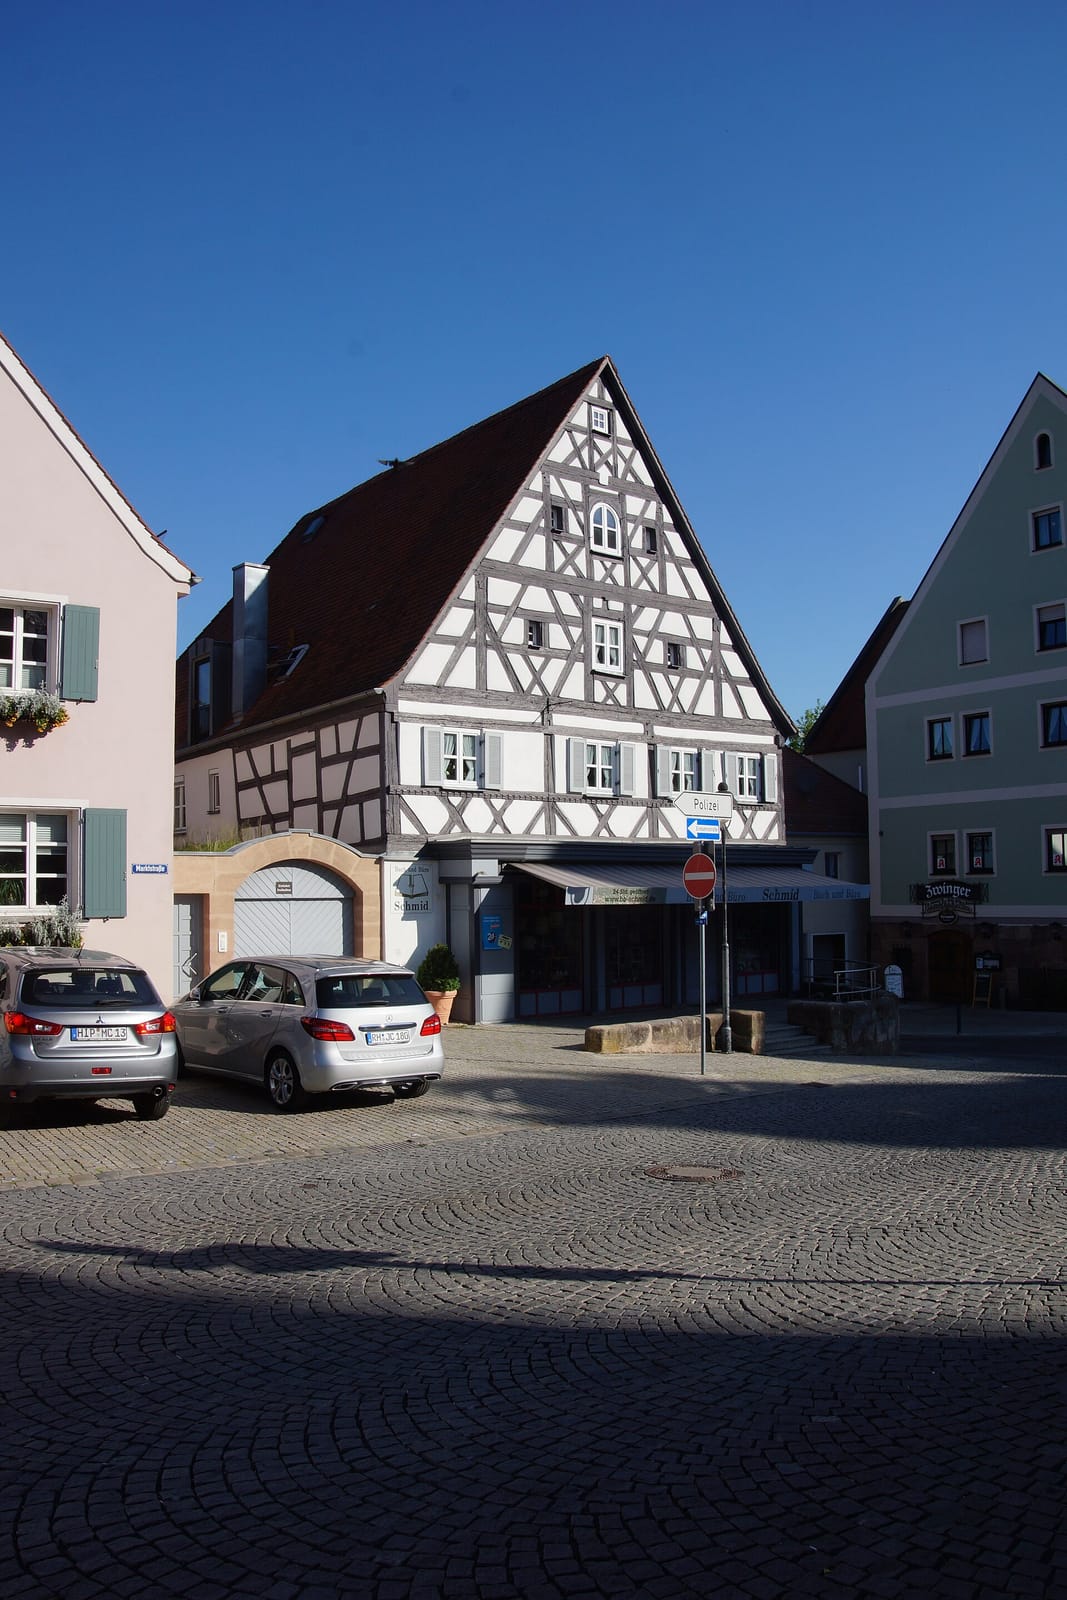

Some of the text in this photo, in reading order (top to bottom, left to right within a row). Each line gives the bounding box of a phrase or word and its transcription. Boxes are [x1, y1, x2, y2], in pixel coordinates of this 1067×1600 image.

[693, 798, 720, 811] Polizei
[763, 888, 800, 901] Schmid
[925, 882, 971, 898] Zwinger
[394, 900, 429, 911] Schmid
[77, 1028, 126, 1038] HIP MC 13
[372, 1033, 382, 1042] RH
